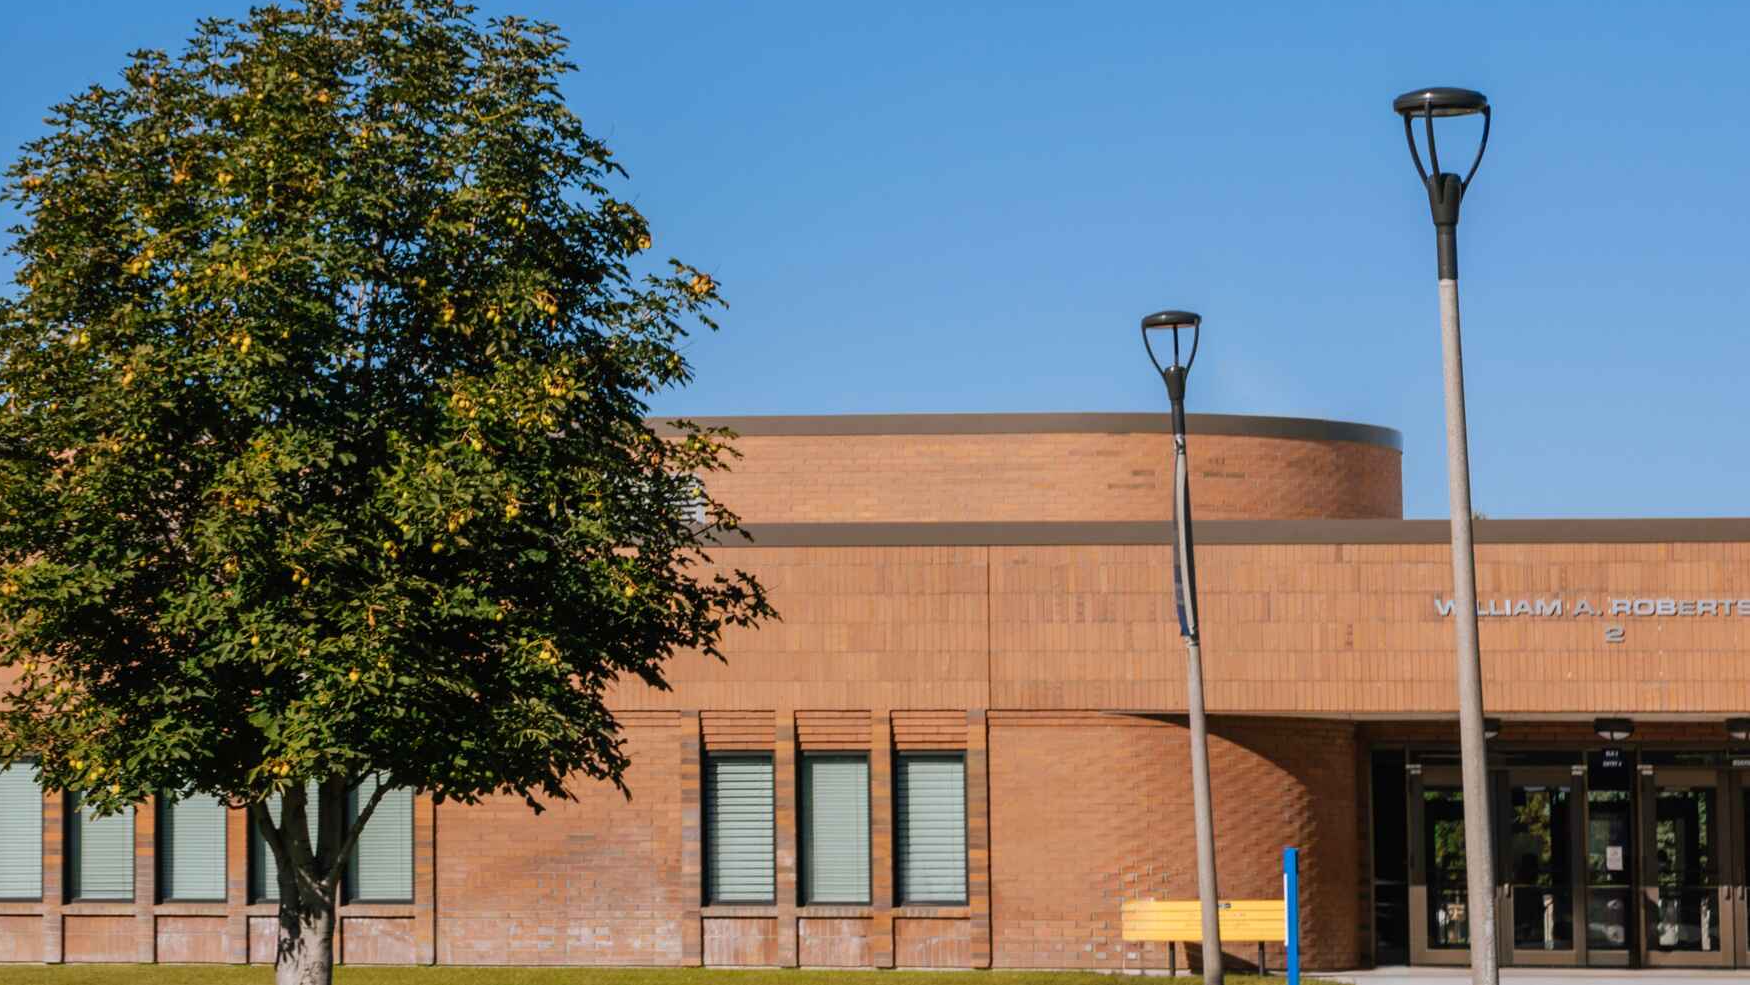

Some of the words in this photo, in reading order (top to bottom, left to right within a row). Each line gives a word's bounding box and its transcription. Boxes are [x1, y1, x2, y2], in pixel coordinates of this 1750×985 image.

[1434, 599, 1564, 616] WLLIAM
[1573, 599, 1604, 616] A.
[1605, 625, 1626, 644] 2
